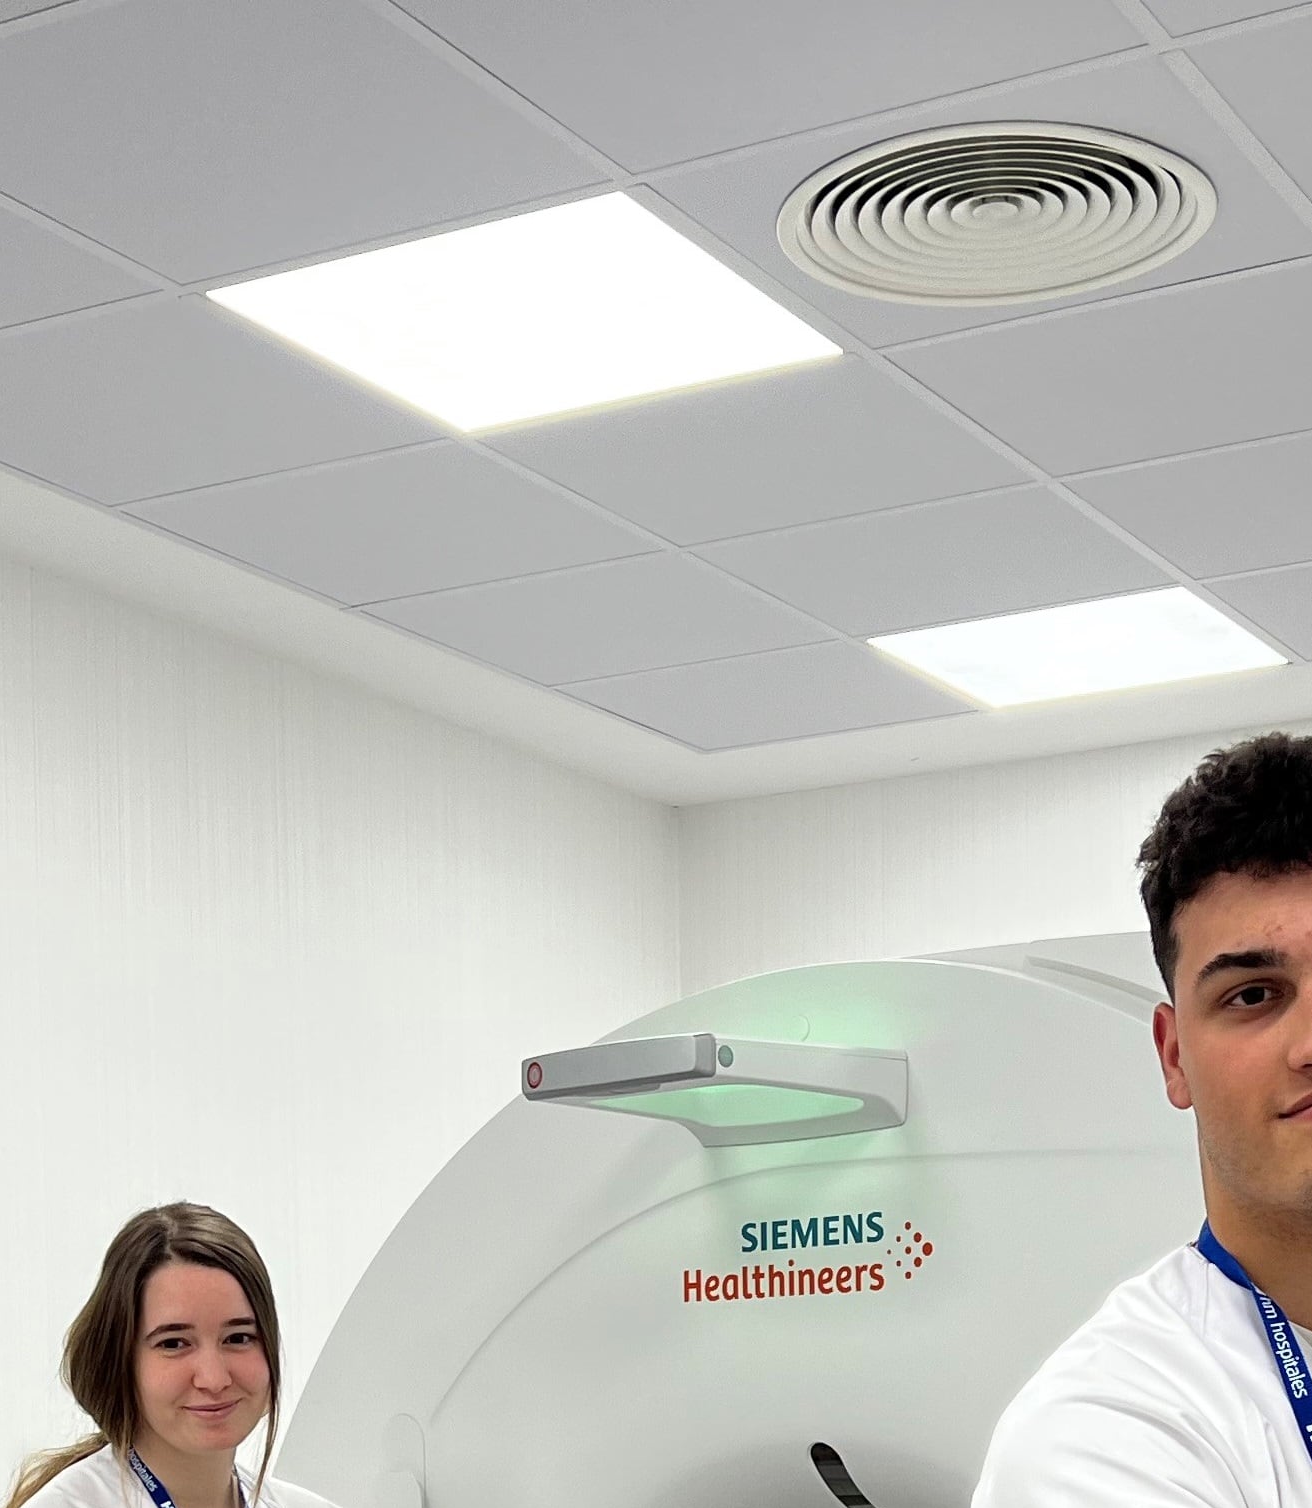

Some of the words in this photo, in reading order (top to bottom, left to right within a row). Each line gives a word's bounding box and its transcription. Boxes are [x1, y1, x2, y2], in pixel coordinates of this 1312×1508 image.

[741, 1211, 885, 1253] SIEMENS
[683, 1259, 885, 1303] Healthineers
[1270, 1321, 1309, 1400] hospitales
